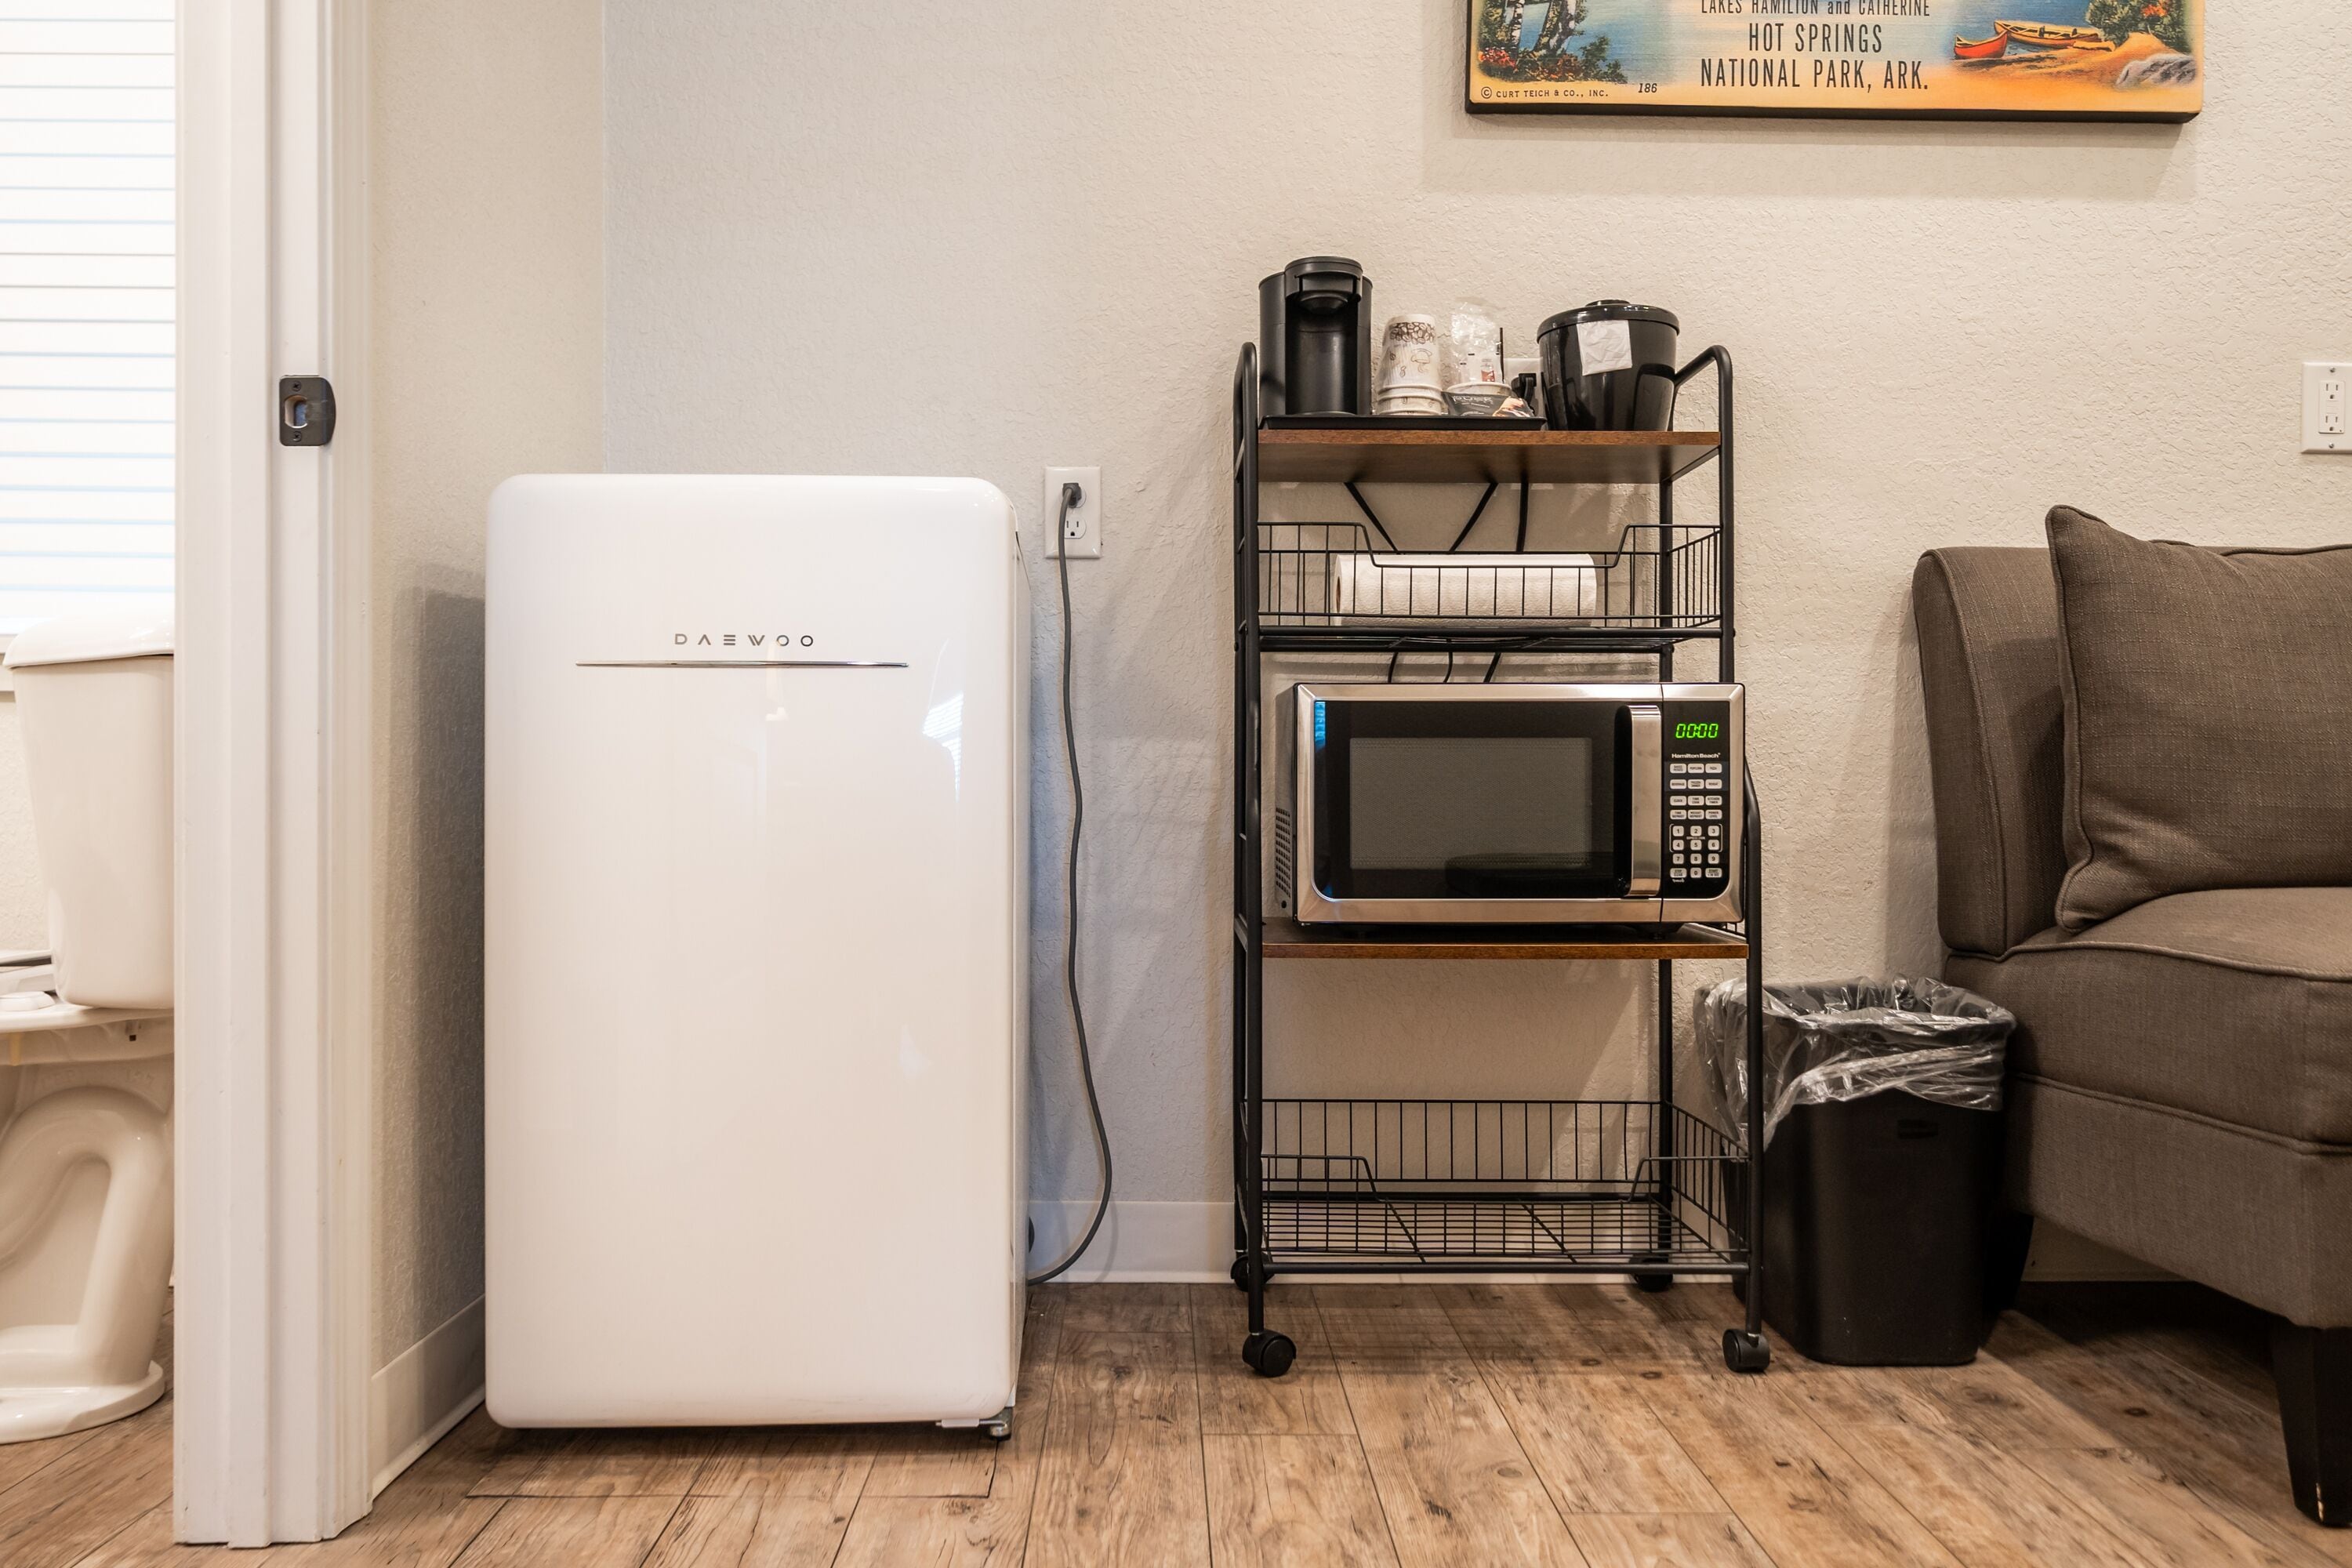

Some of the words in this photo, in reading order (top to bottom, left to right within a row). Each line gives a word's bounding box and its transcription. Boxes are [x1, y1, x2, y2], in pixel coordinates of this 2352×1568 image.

[1701, 0, 1742, 14] LAKES
[1751, 0, 1818, 14] HAMILTON
[1828, 0, 1850, 15] and
[1859, 0, 1930, 16] CATHERINE
[1749, 22, 1784, 52] HOT
[1795, 23, 1882, 53] SPRINGS
[1700, 58, 1801, 88] NATIONAL
[1813, 59, 1871, 93] PARK,
[1883, 60, 1928, 90] ARK.
[1638, 82, 1658, 93] 186
[673, 633, 815, 648] DAEWOO
[1675, 723, 1719, 739] 00:00
